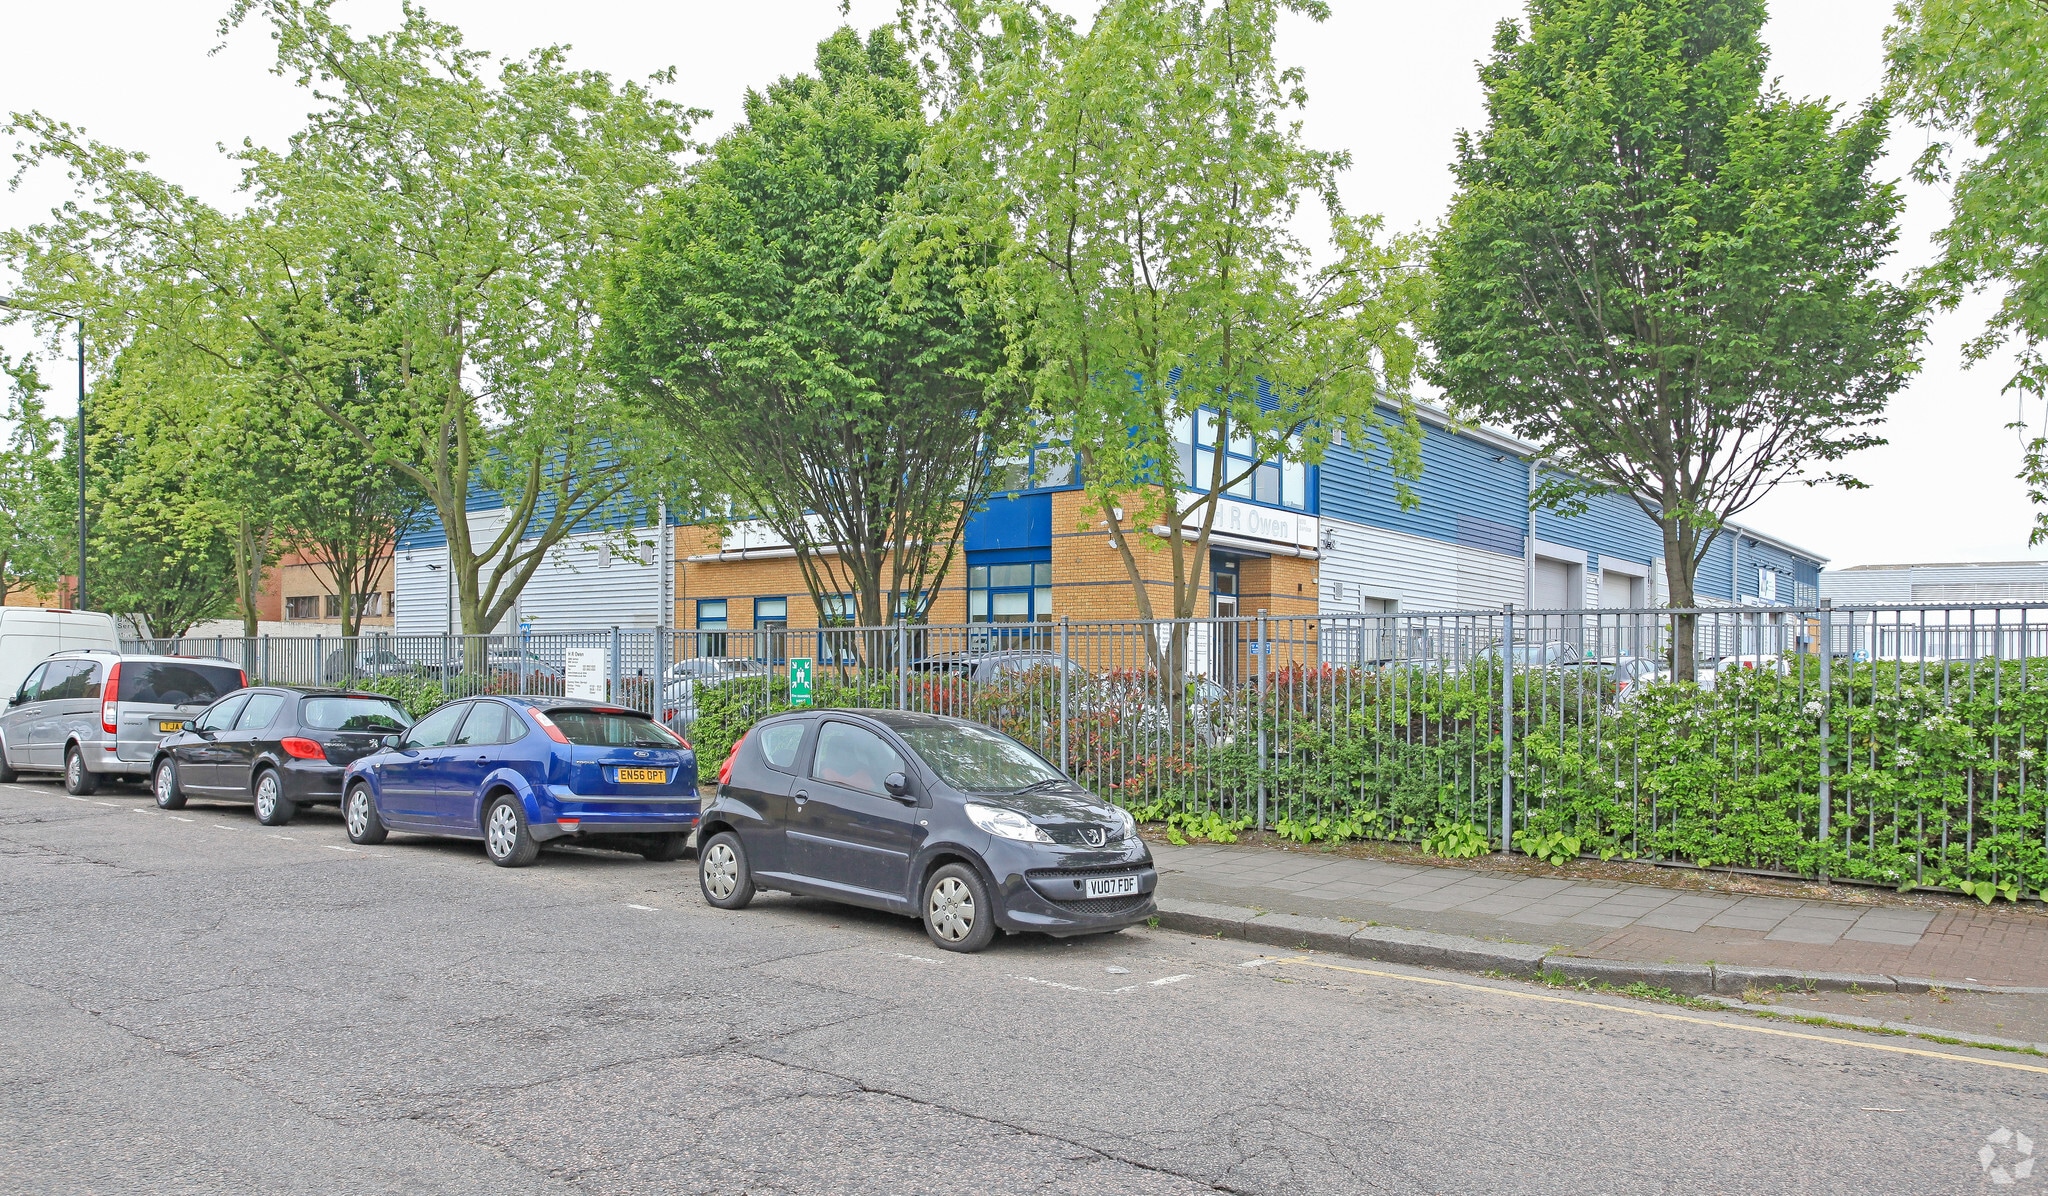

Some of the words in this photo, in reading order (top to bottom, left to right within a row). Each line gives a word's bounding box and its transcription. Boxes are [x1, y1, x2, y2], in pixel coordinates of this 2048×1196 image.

[1230, 505, 1241, 531] R
[1248, 509, 1288, 539] Owen
[117, 622, 146, 630] Serve
[620, 770, 645, 780] EN56
[647, 771, 664, 781] OPT
[1091, 879, 1116, 895] VU07
[1118, 877, 1135, 893] FDF
